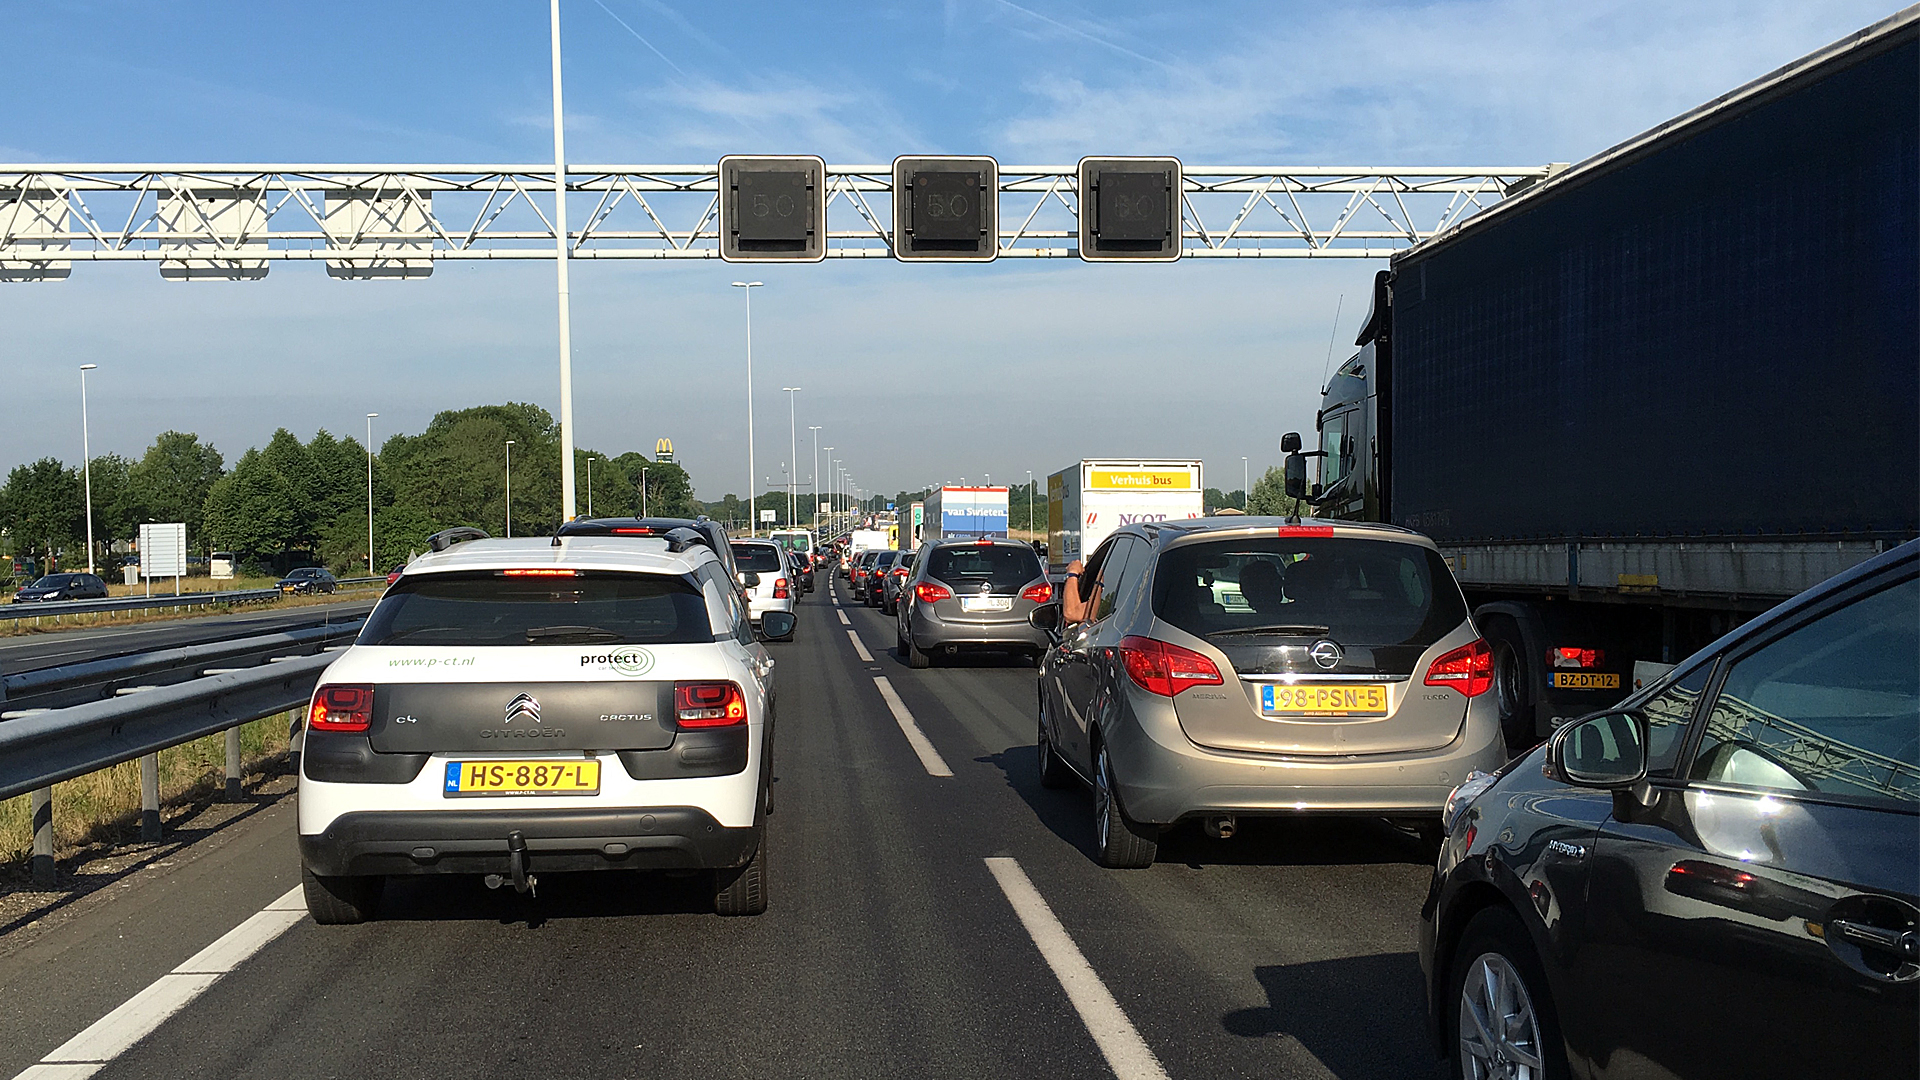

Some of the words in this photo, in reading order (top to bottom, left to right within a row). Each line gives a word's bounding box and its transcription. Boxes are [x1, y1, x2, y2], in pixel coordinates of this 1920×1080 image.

[753, 194, 794, 217] 50
[928, 194, 968, 217] 50
[947, 508, 965, 516] van
[966, 507, 1004, 516] Swieten
[389, 656, 475, 668] www.p-ct.nl
[581, 653, 638, 667] protect
[1560, 674, 1613, 687] BZ-DT-12
[1280, 689, 1380, 708] 98-PSN-5
[600, 713, 652, 721] CACTUS
[470, 765, 589, 787] HS-887-L
